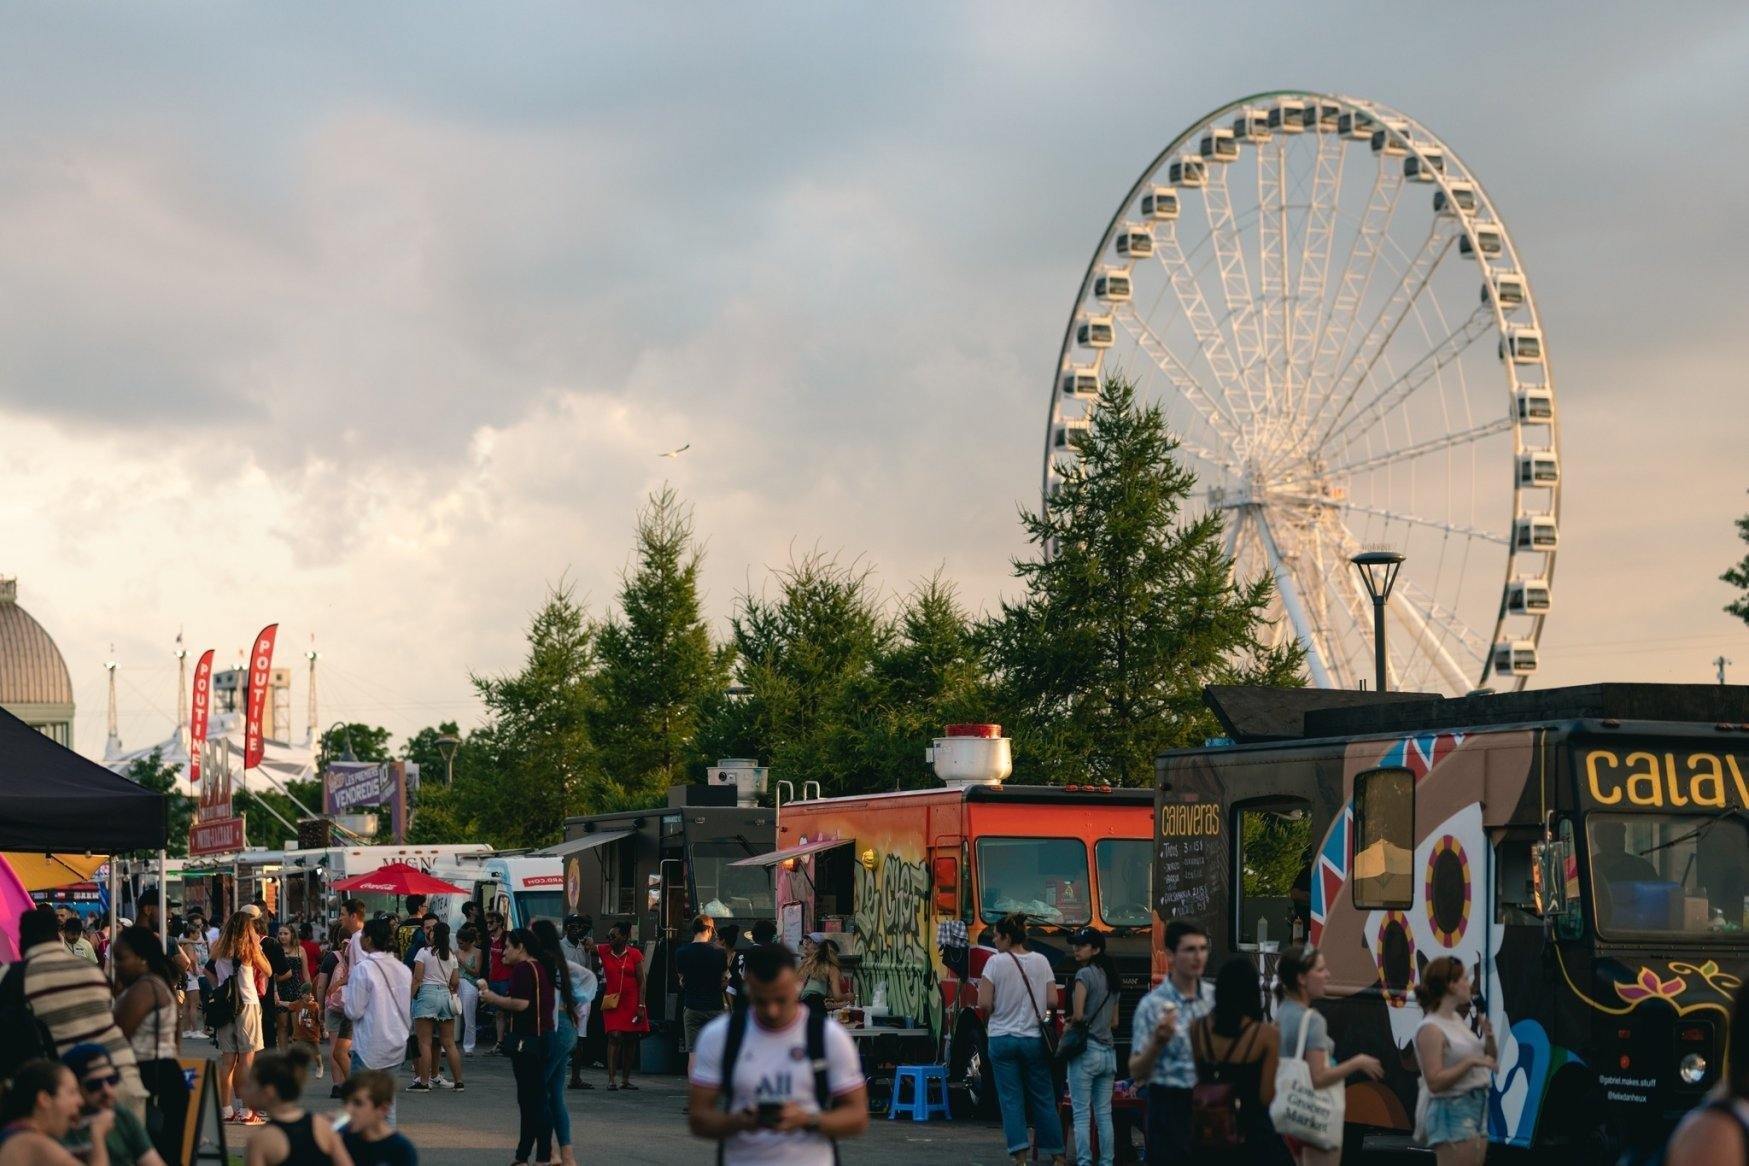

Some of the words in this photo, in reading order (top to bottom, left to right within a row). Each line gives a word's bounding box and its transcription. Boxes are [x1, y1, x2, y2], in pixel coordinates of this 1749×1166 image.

[192, 664, 209, 767] POUTINE
[249, 640, 271, 751] POUTINE
[334, 778, 380, 809] VENDREDIS
